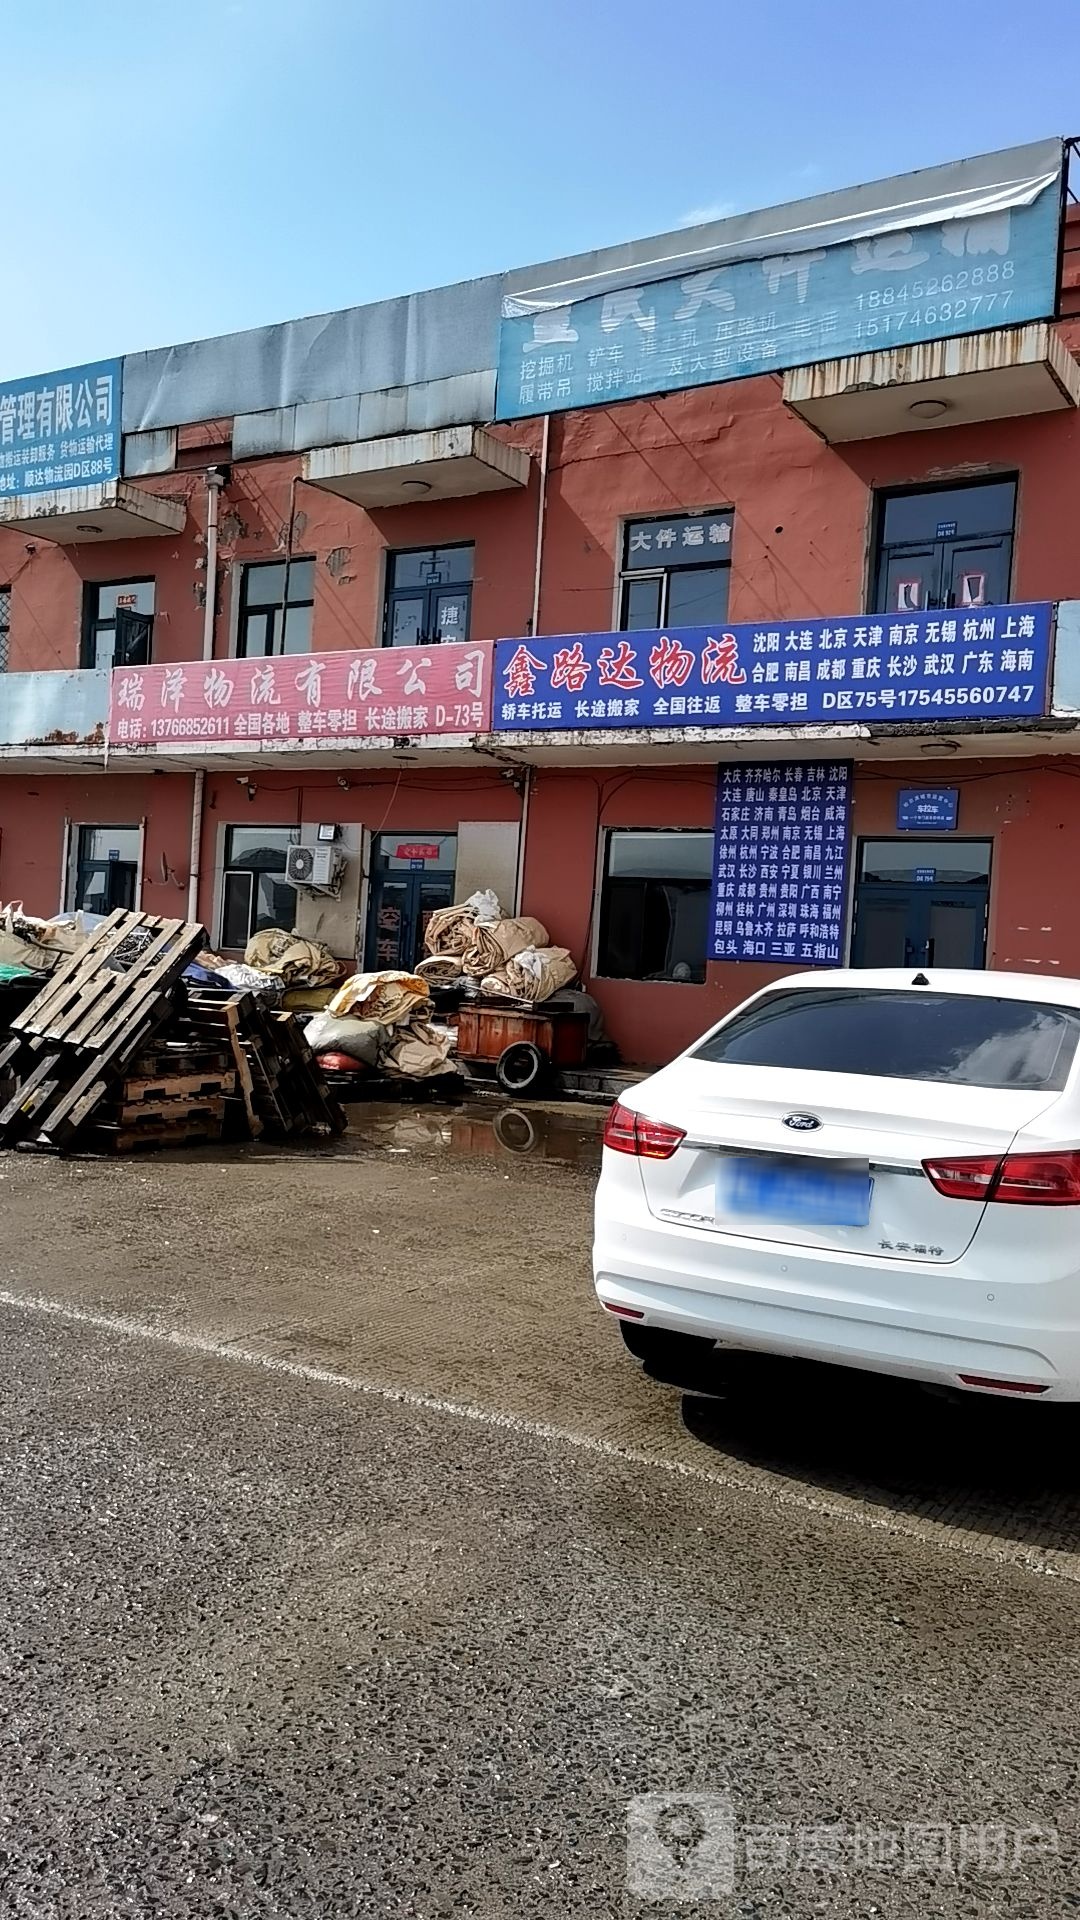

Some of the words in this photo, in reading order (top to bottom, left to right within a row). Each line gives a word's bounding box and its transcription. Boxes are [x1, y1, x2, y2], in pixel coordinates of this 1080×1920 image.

[855, 260, 1015, 311] 18845262888
[855, 290, 1014, 339] 15174632777
[519, 354, 574, 381] 挖掘机
[587, 344, 624, 367] 铲车
[518, 377, 572, 405] 履带吊
[586, 368, 644, 393] 搅拌站
[0, 375, 113, 446] 管理有限公司
[630, 523, 731, 551] 大件运输
[753, 632, 779, 653] 沈阳
[785, 630, 813, 652] 大连
[819, 628, 848, 650] 北京
[853, 626, 882, 648] 天津
[889, 623, 919, 645] 南京
[925, 621, 956, 644] 无锡
[963, 618, 995, 642] 杭州
[1001, 615, 1035, 639] 上海
[503, 633, 747, 698] 鑫路达物流
[752, 662, 779, 683] 合肥
[785, 660, 811, 682] 南昌
[817, 658, 845, 681] 成都
[851, 656, 881, 679] 重庆
[887, 655, 917, 678] 长沙
[924, 653, 955, 675] 武汉
[962, 651, 993, 674] 广东
[1001, 648, 1034, 672] 海南
[118, 649, 485, 713] 瑞泽物流有限公司
[234, 712, 290, 736] 全国各地
[298, 709, 357, 733] 整车零担
[365, 705, 429, 731] 长途搬家
[436, 701, 484, 728] D-73号
[502, 702, 562, 721] 轿车托运
[575, 699, 640, 718] 长途搬家
[653, 696, 721, 715] 全国往返
[735, 692, 808, 713] 整车零担
[723, 769, 741, 783] 大庆
[745, 768, 781, 783] 齐齐哈尔
[785, 767, 803, 782] 长春
[807, 767, 825, 782] 吉林
[829, 766, 848, 781] 沈阳
[722, 788, 742, 802] 大连
[745, 787, 764, 802] 唐山
[768, 787, 797, 801] 秦皇岛
[801, 786, 821, 801] 北京
[826, 786, 846, 801] 天津
[722, 807, 750, 821] 石家庄
[754, 807, 774, 821] 济南
[778, 806, 796, 821] 青岛
[801, 806, 821, 821] 烟台
[825, 806, 846, 821] 威海
[720, 826, 738, 840] 太原
[741, 826, 758, 840] 大同
[761, 826, 780, 840] 郑州
[783, 826, 800, 840] 南京
[804, 825, 823, 840] 无锡
[826, 825, 845, 841] 上海
[719, 845, 736, 860] 徐州
[740, 845, 757, 860] 杭州
[761, 845, 778, 860] 宁波
[782, 845, 800, 860] 合肥
[804, 845, 821, 860] 南昌
[825, 846, 843, 860] 九江
[718, 864, 735, 878] 武汉
[739, 864, 757, 879] 长沙
[760, 864, 778, 879] 西安
[782, 864, 799, 879] 宁夏
[803, 865, 821, 880] 银川
[825, 865, 843, 880] 兰州
[717, 883, 735, 897] 重庆
[738, 883, 756, 898] 成都
[759, 884, 777, 898] 贵州
[780, 884, 798, 899] 贵阳
[801, 884, 820, 899] 广西
[823, 885, 842, 900] 南宁
[716, 902, 733, 916] 柳州
[736, 902, 754, 917] 桂林
[757, 903, 775, 918] 广州
[778, 903, 797, 918] 深圳
[800, 904, 819, 919] 珠海
[823, 904, 841, 920] 福州
[376, 907, 400, 961] 空车
[715, 921, 732, 935] 昆明
[735, 921, 773, 937] 乌鲁木齐
[777, 922, 796, 938] 拉萨
[800, 923, 840, 940] 呼和浩特
[714, 939, 738, 954] 包头
[743, 940, 765, 955] 海口
[770, 942, 796, 957] 三亚
[801, 943, 839, 959] 五指山
[788, 1117, 814, 1129] Ford
[878, 1239, 944, 1256] 长安福特
